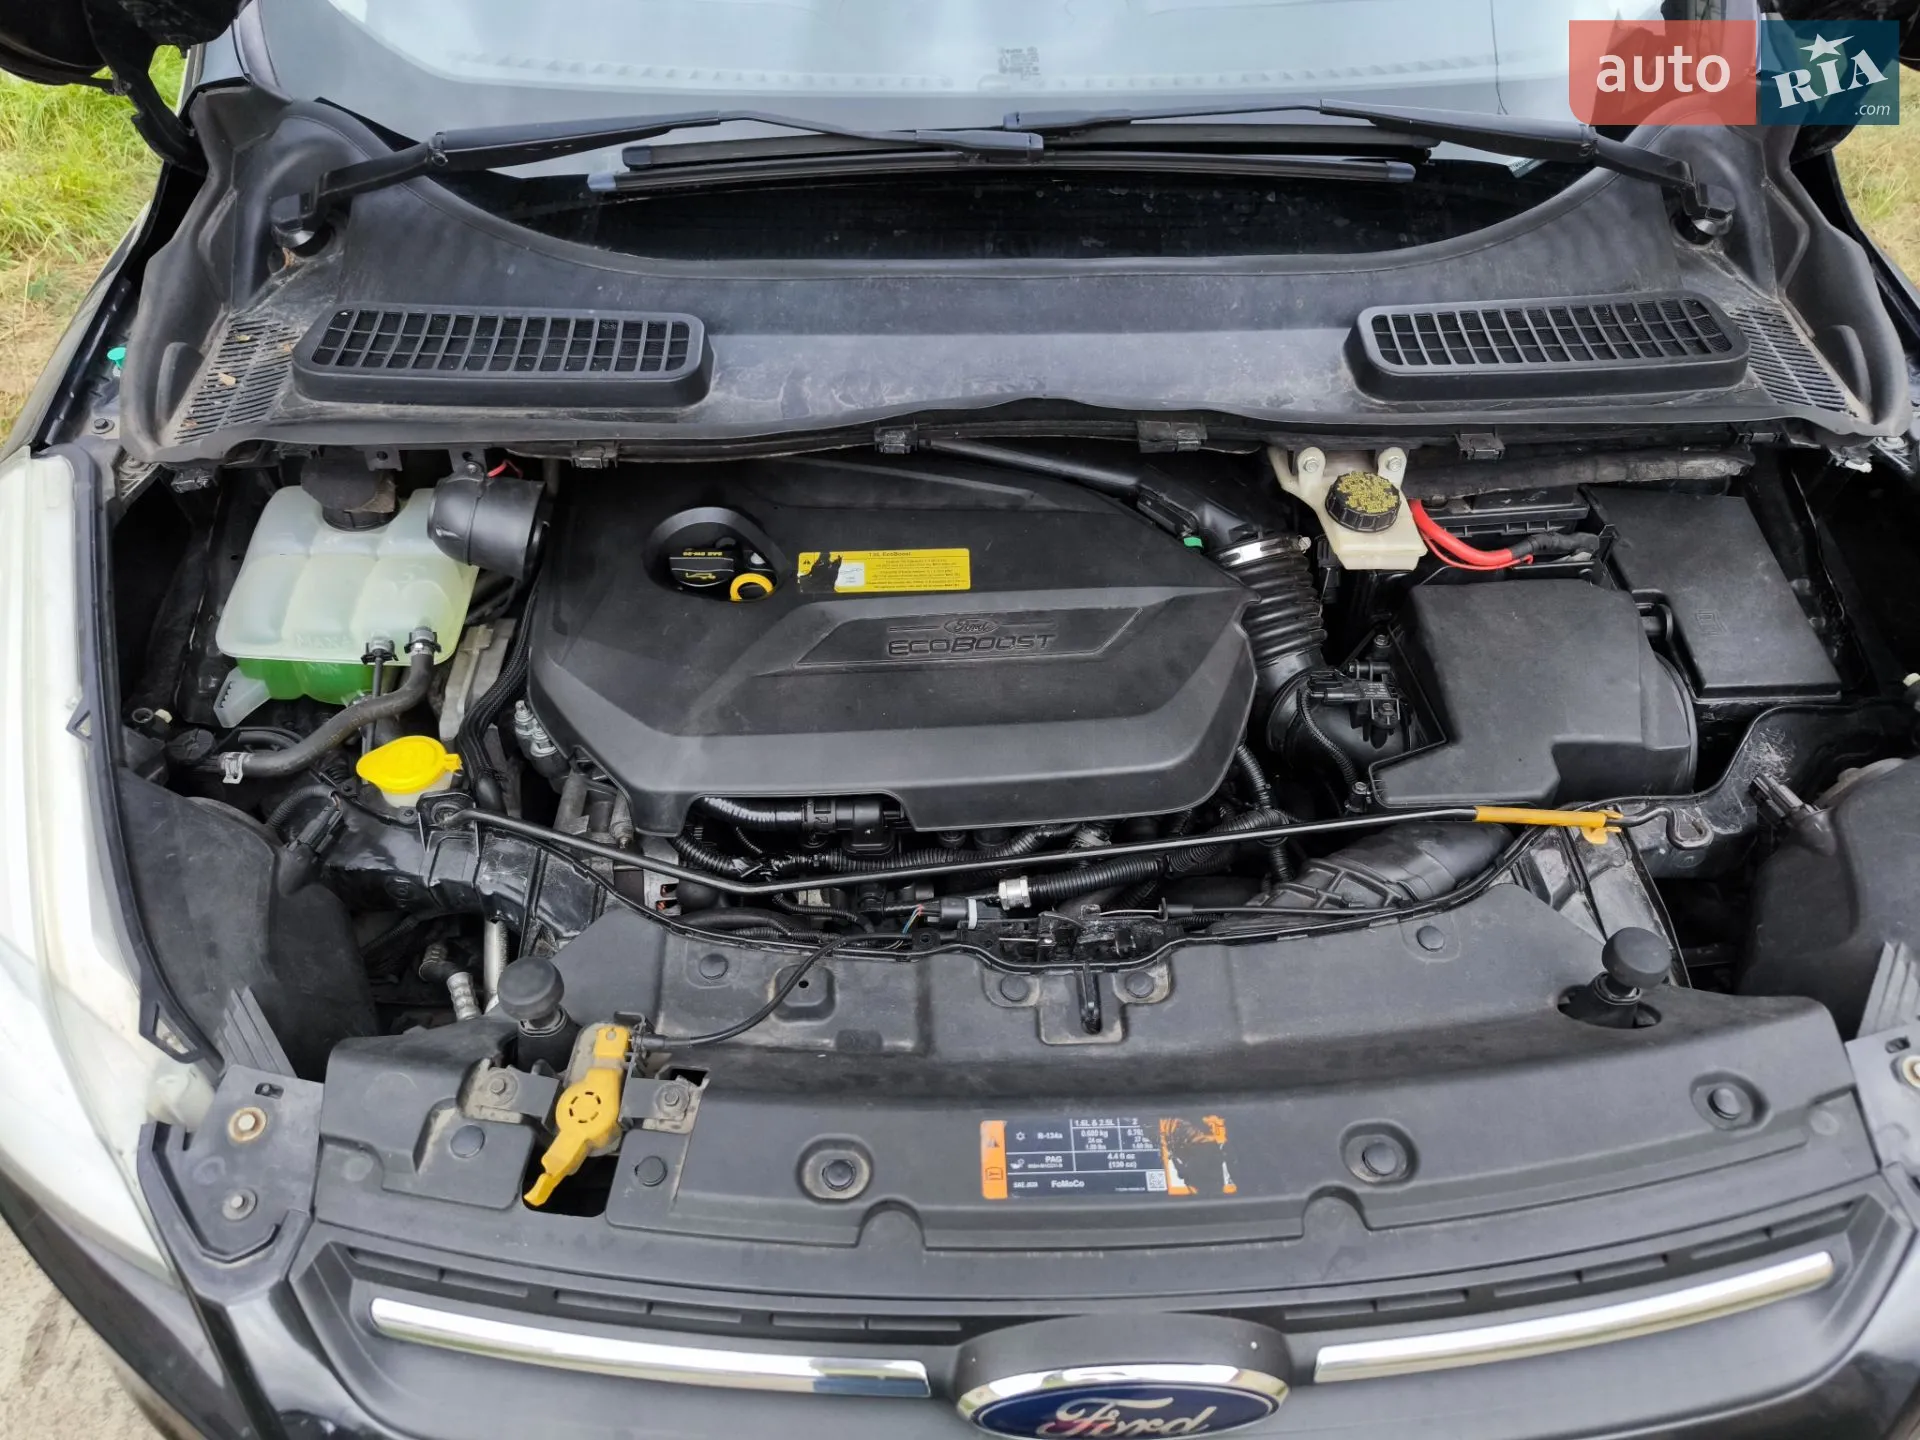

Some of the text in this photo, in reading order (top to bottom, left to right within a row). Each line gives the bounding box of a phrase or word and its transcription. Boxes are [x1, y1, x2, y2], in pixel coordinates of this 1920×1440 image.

[954, 619, 990, 632] Ford
[1099, 1129, 1108, 1138] kg
[1045, 1155, 1063, 1163] PAG
[1051, 1179, 1085, 1188] FoMoCo
[1037, 1396, 1217, 1438] Ford
